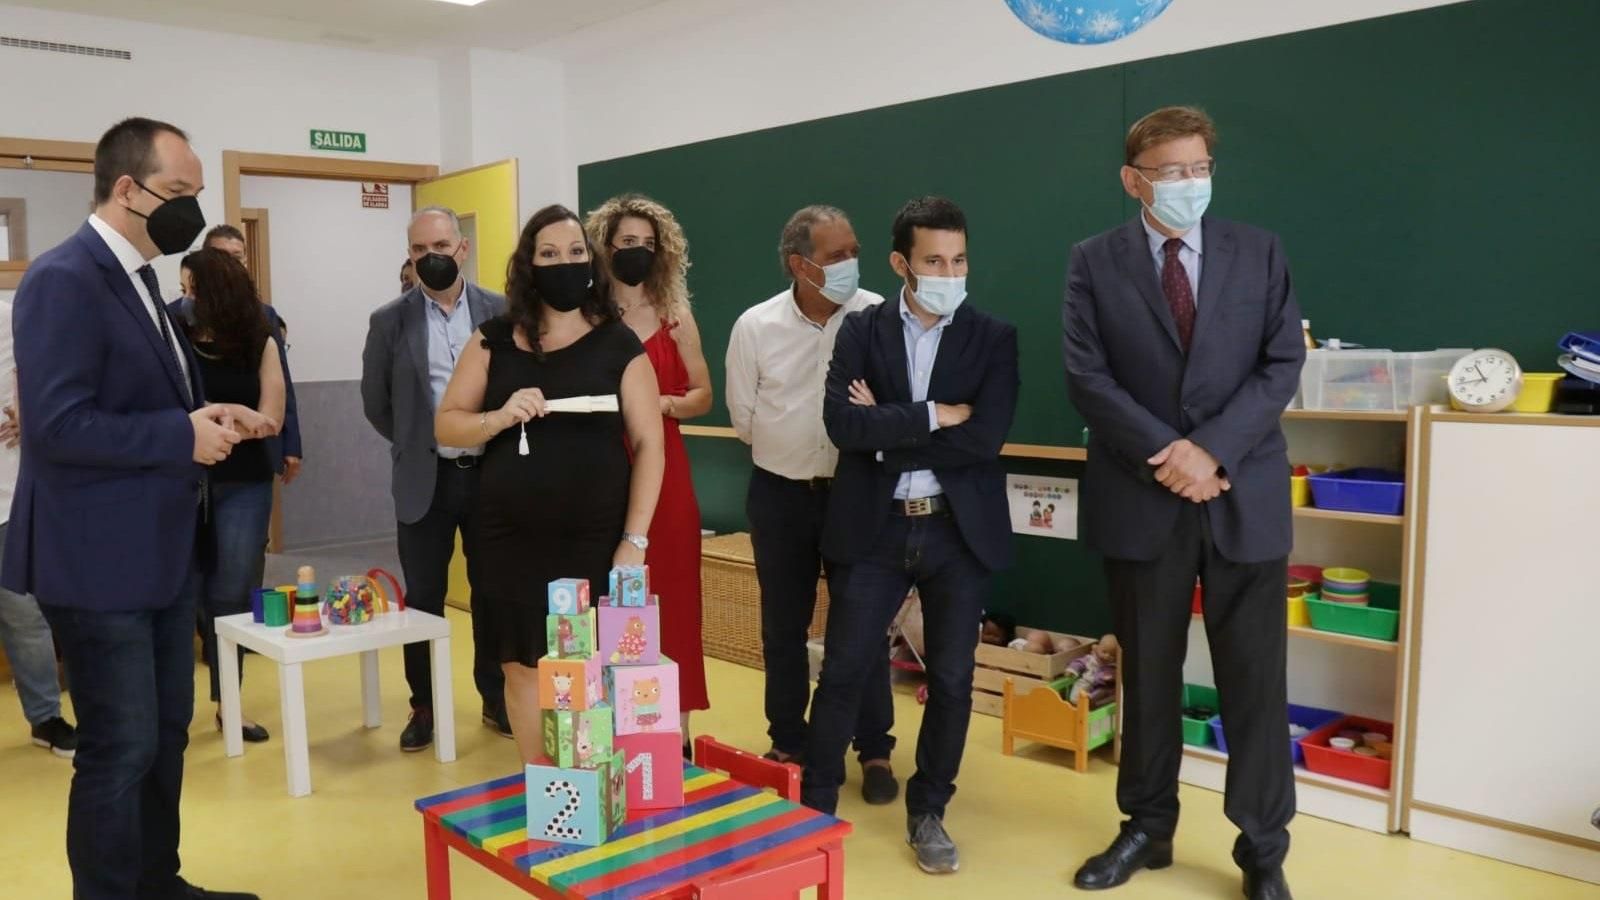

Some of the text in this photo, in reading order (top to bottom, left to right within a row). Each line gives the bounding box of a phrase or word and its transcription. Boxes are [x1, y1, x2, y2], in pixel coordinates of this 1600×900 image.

[314, 131, 362, 149] SALIDA
[552, 587, 572, 614] 9
[625, 752, 653, 800] 1
[544, 779, 582, 840] 2
